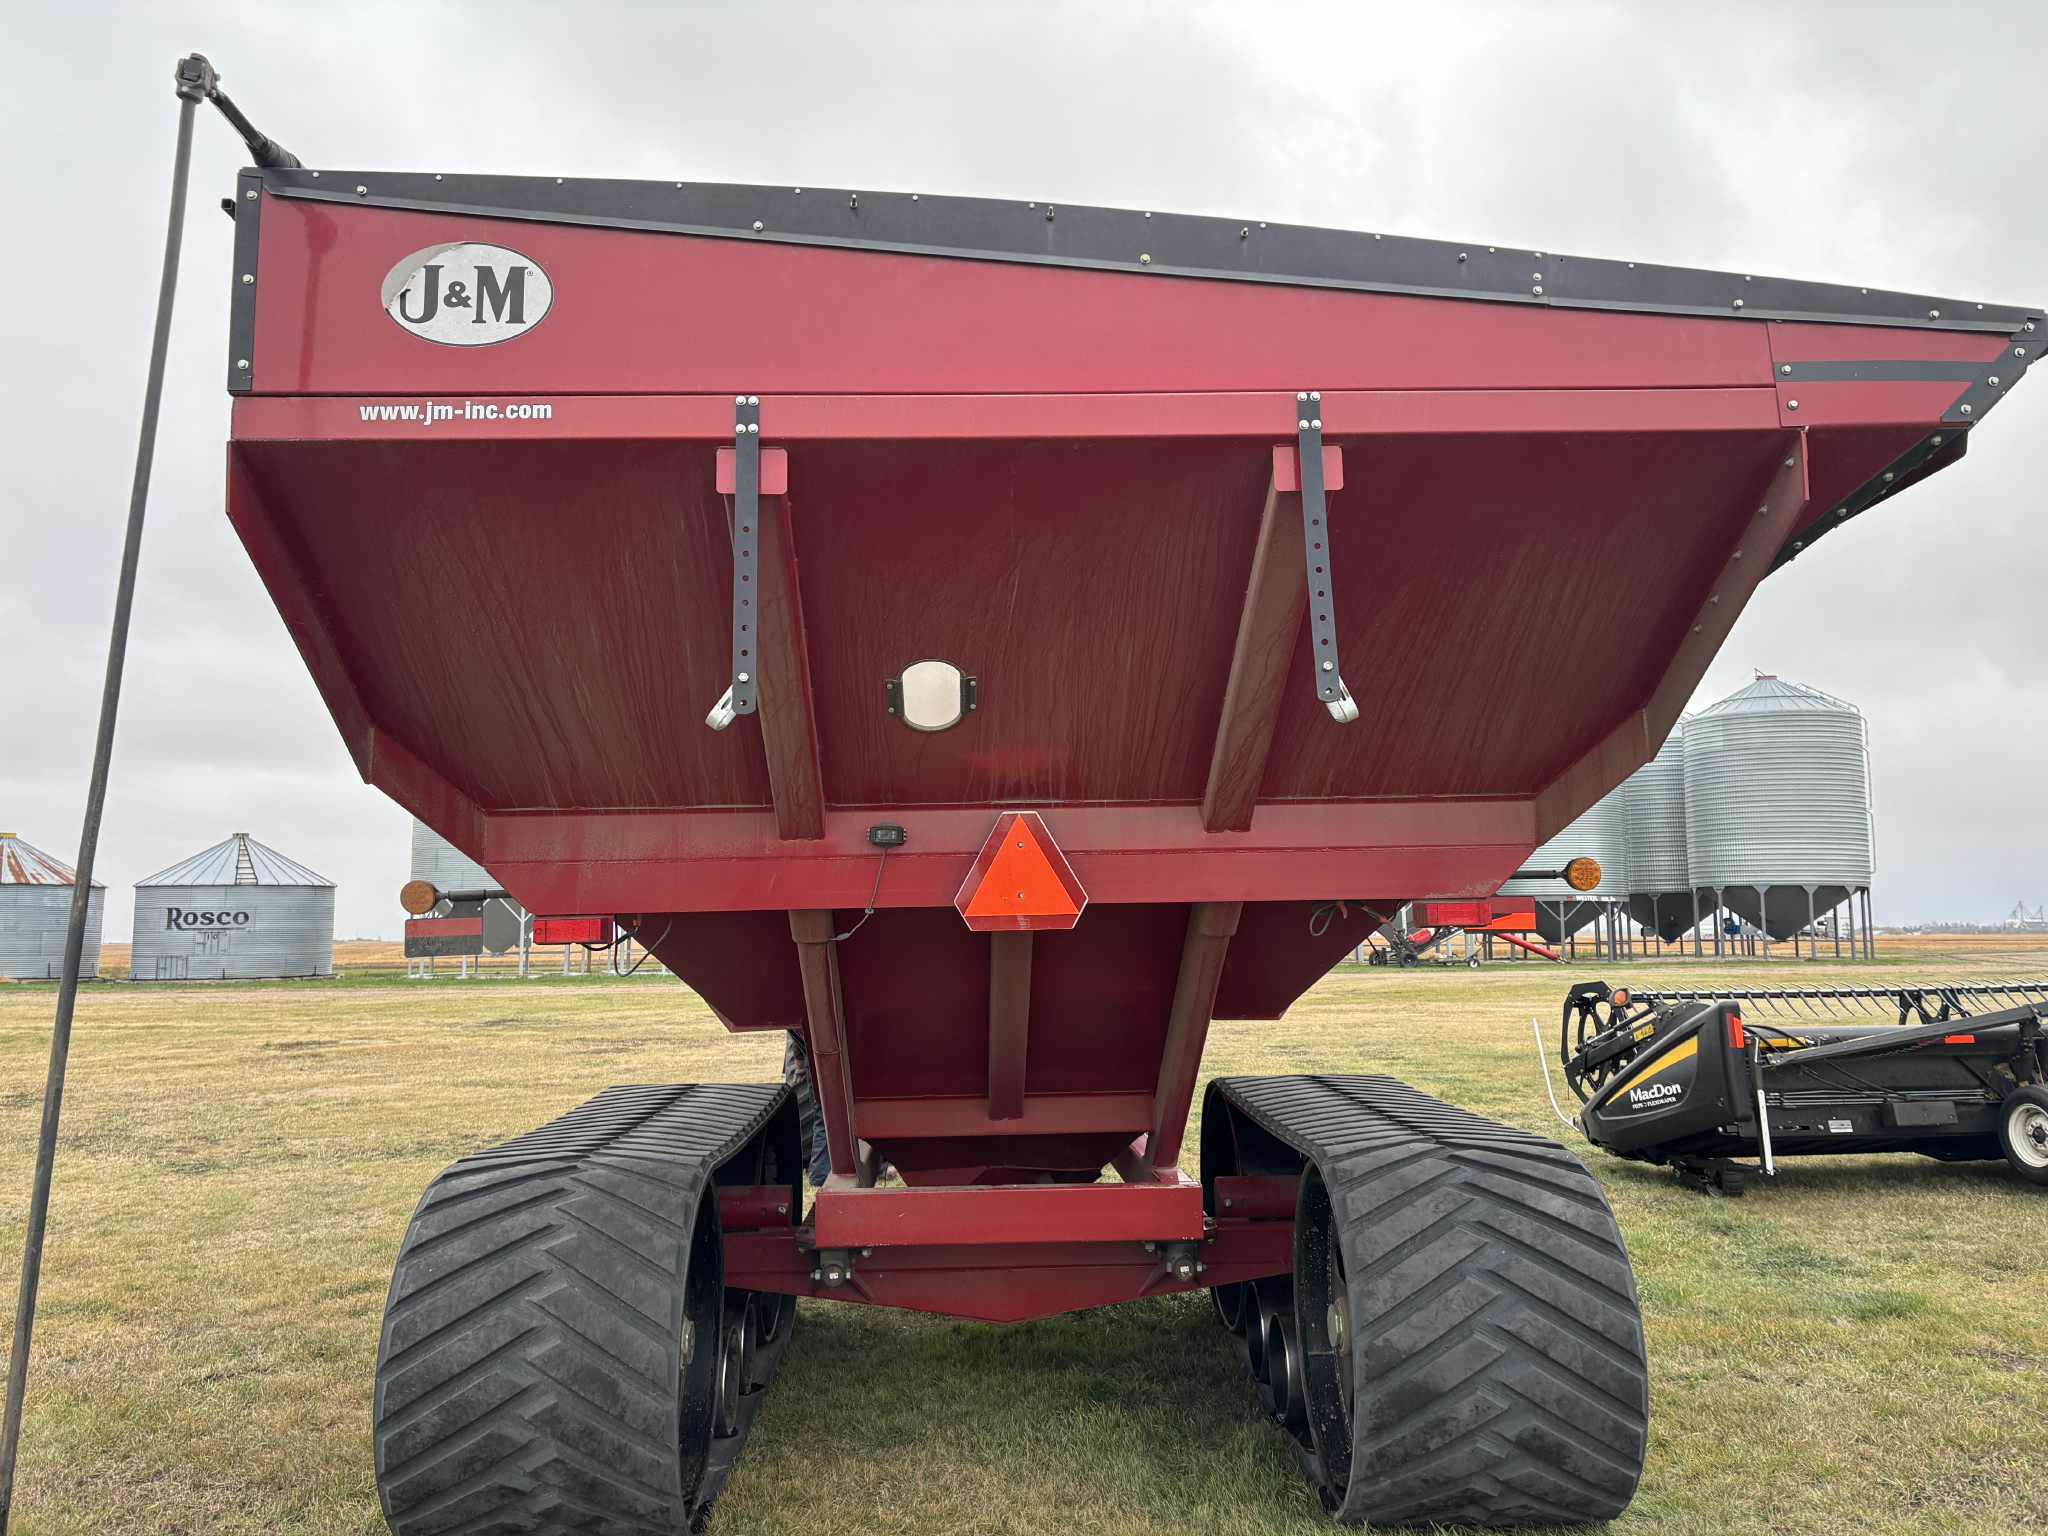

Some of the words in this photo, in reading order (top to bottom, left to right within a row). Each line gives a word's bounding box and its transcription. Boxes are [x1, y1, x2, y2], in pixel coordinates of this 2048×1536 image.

[399, 264, 529, 324] J&M
[359, 401, 552, 425] www.jm-inc.com
[165, 907, 250, 930] Rosco
[1630, 1083, 1682, 1103] MacDon
